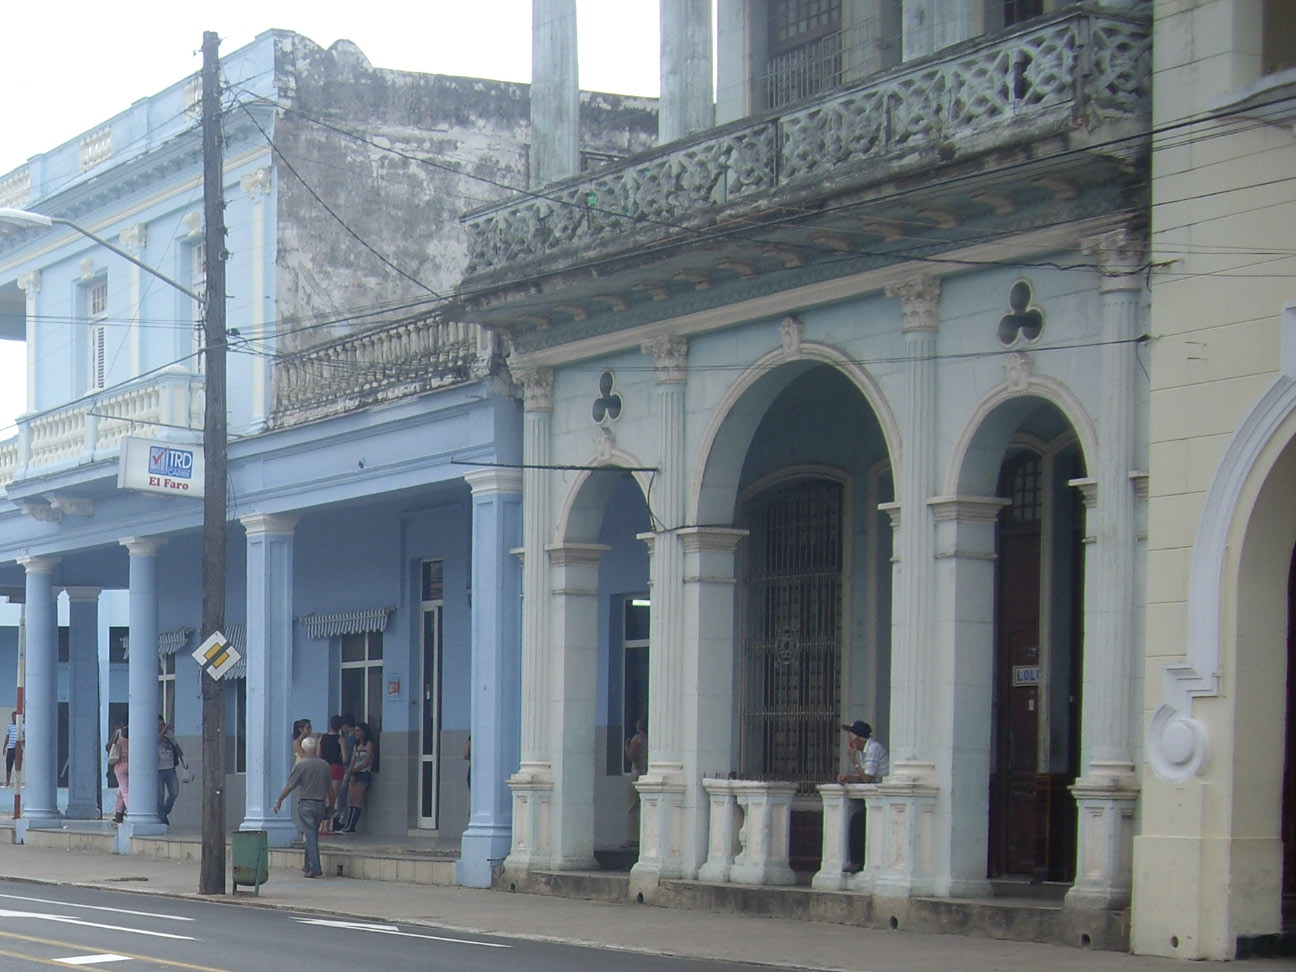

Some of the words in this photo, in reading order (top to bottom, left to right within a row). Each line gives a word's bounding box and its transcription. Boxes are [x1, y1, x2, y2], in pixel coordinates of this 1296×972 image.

[169, 450, 192, 469] TRD
[149, 476, 161, 486] El
[164, 478, 189, 490] Faro
